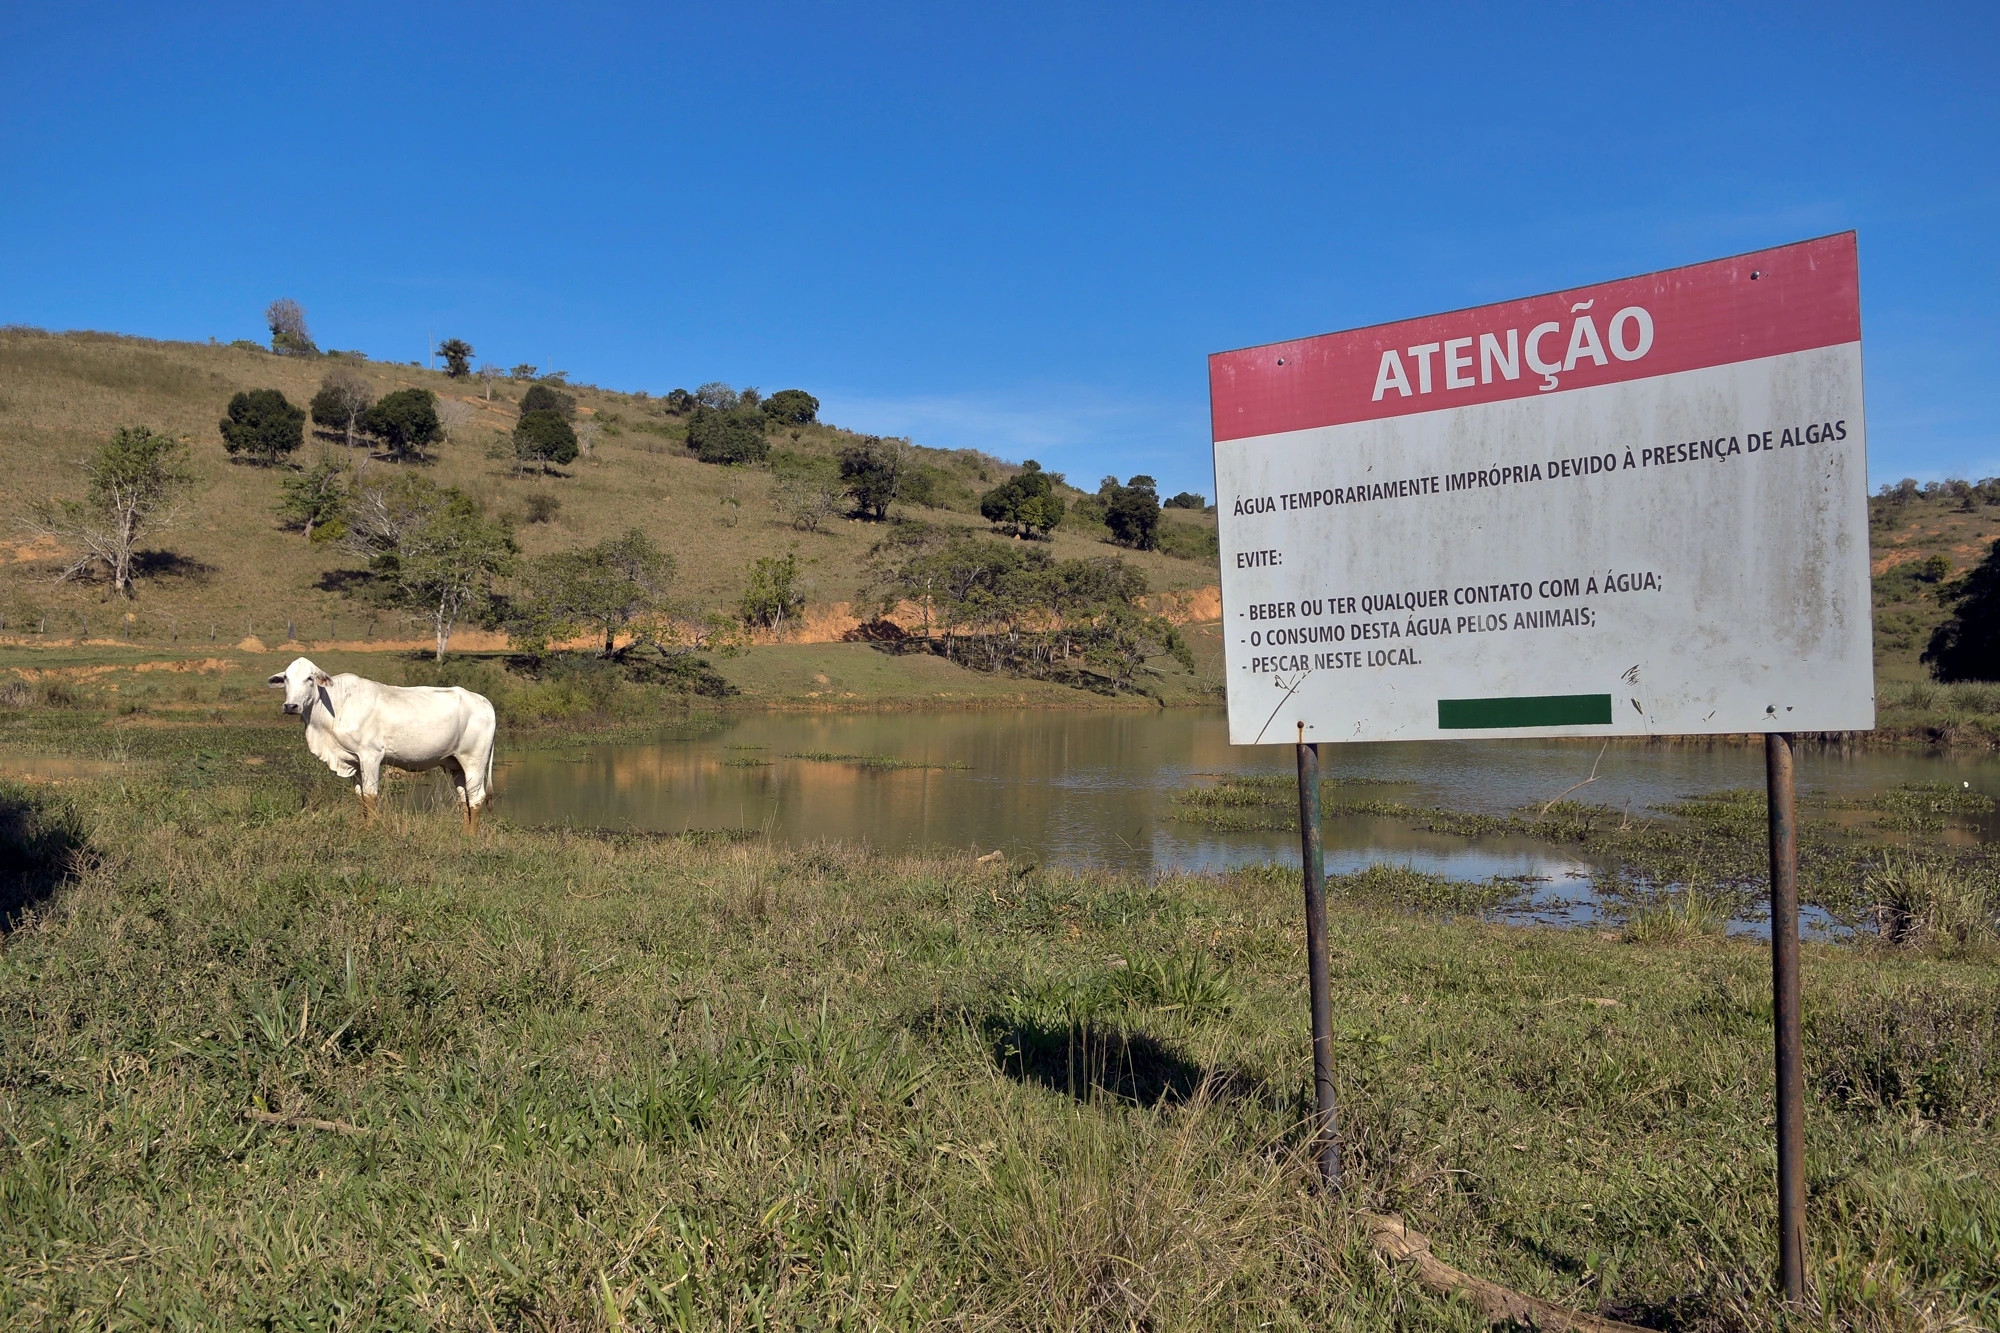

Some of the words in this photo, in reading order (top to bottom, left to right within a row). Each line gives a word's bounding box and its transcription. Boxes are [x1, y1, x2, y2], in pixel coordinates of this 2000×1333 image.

[1370, 298, 1656, 403] ATENÇÃO
[1233, 494, 1277, 517] ÁGUA
[1279, 475, 1440, 511] TEMPORARIAMENTE
[1445, 462, 1543, 492] IMPRÓPRIA
[1547, 453, 1617, 480] DEVIDO
[1622, 445, 1637, 470] À
[1641, 435, 1741, 468] PRESENÇA
[1747, 430, 1774, 453] DE
[1779, 419, 1847, 449] ALGAS
[1236, 549, 1283, 569] EVITE:
[1249, 601, 1297, 621] BEBER
[1300, 599, 1323, 617] OU
[1327, 596, 1357, 615] TER
[1361, 589, 1449, 615] QUALQUER
[1453, 581, 1533, 606] CONTATO
[1538, 577, 1580, 599] COM
[1585, 576, 1599, 596] A
[1603, 568, 1662, 594] ÁGUA;
[1250, 630, 1262, 647] O
[1266, 624, 1346, 646] CONSUMO
[1350, 621, 1401, 641] DESTA
[1405, 614, 1453, 638] ÁGUA
[1456, 612, 1508, 634] PELOS
[1513, 606, 1596, 630] ANIMAIS;
[1251, 654, 1310, 674] PESCAR
[1314, 651, 1363, 670] NESTE
[1367, 647, 1422, 668] LOCAL.
